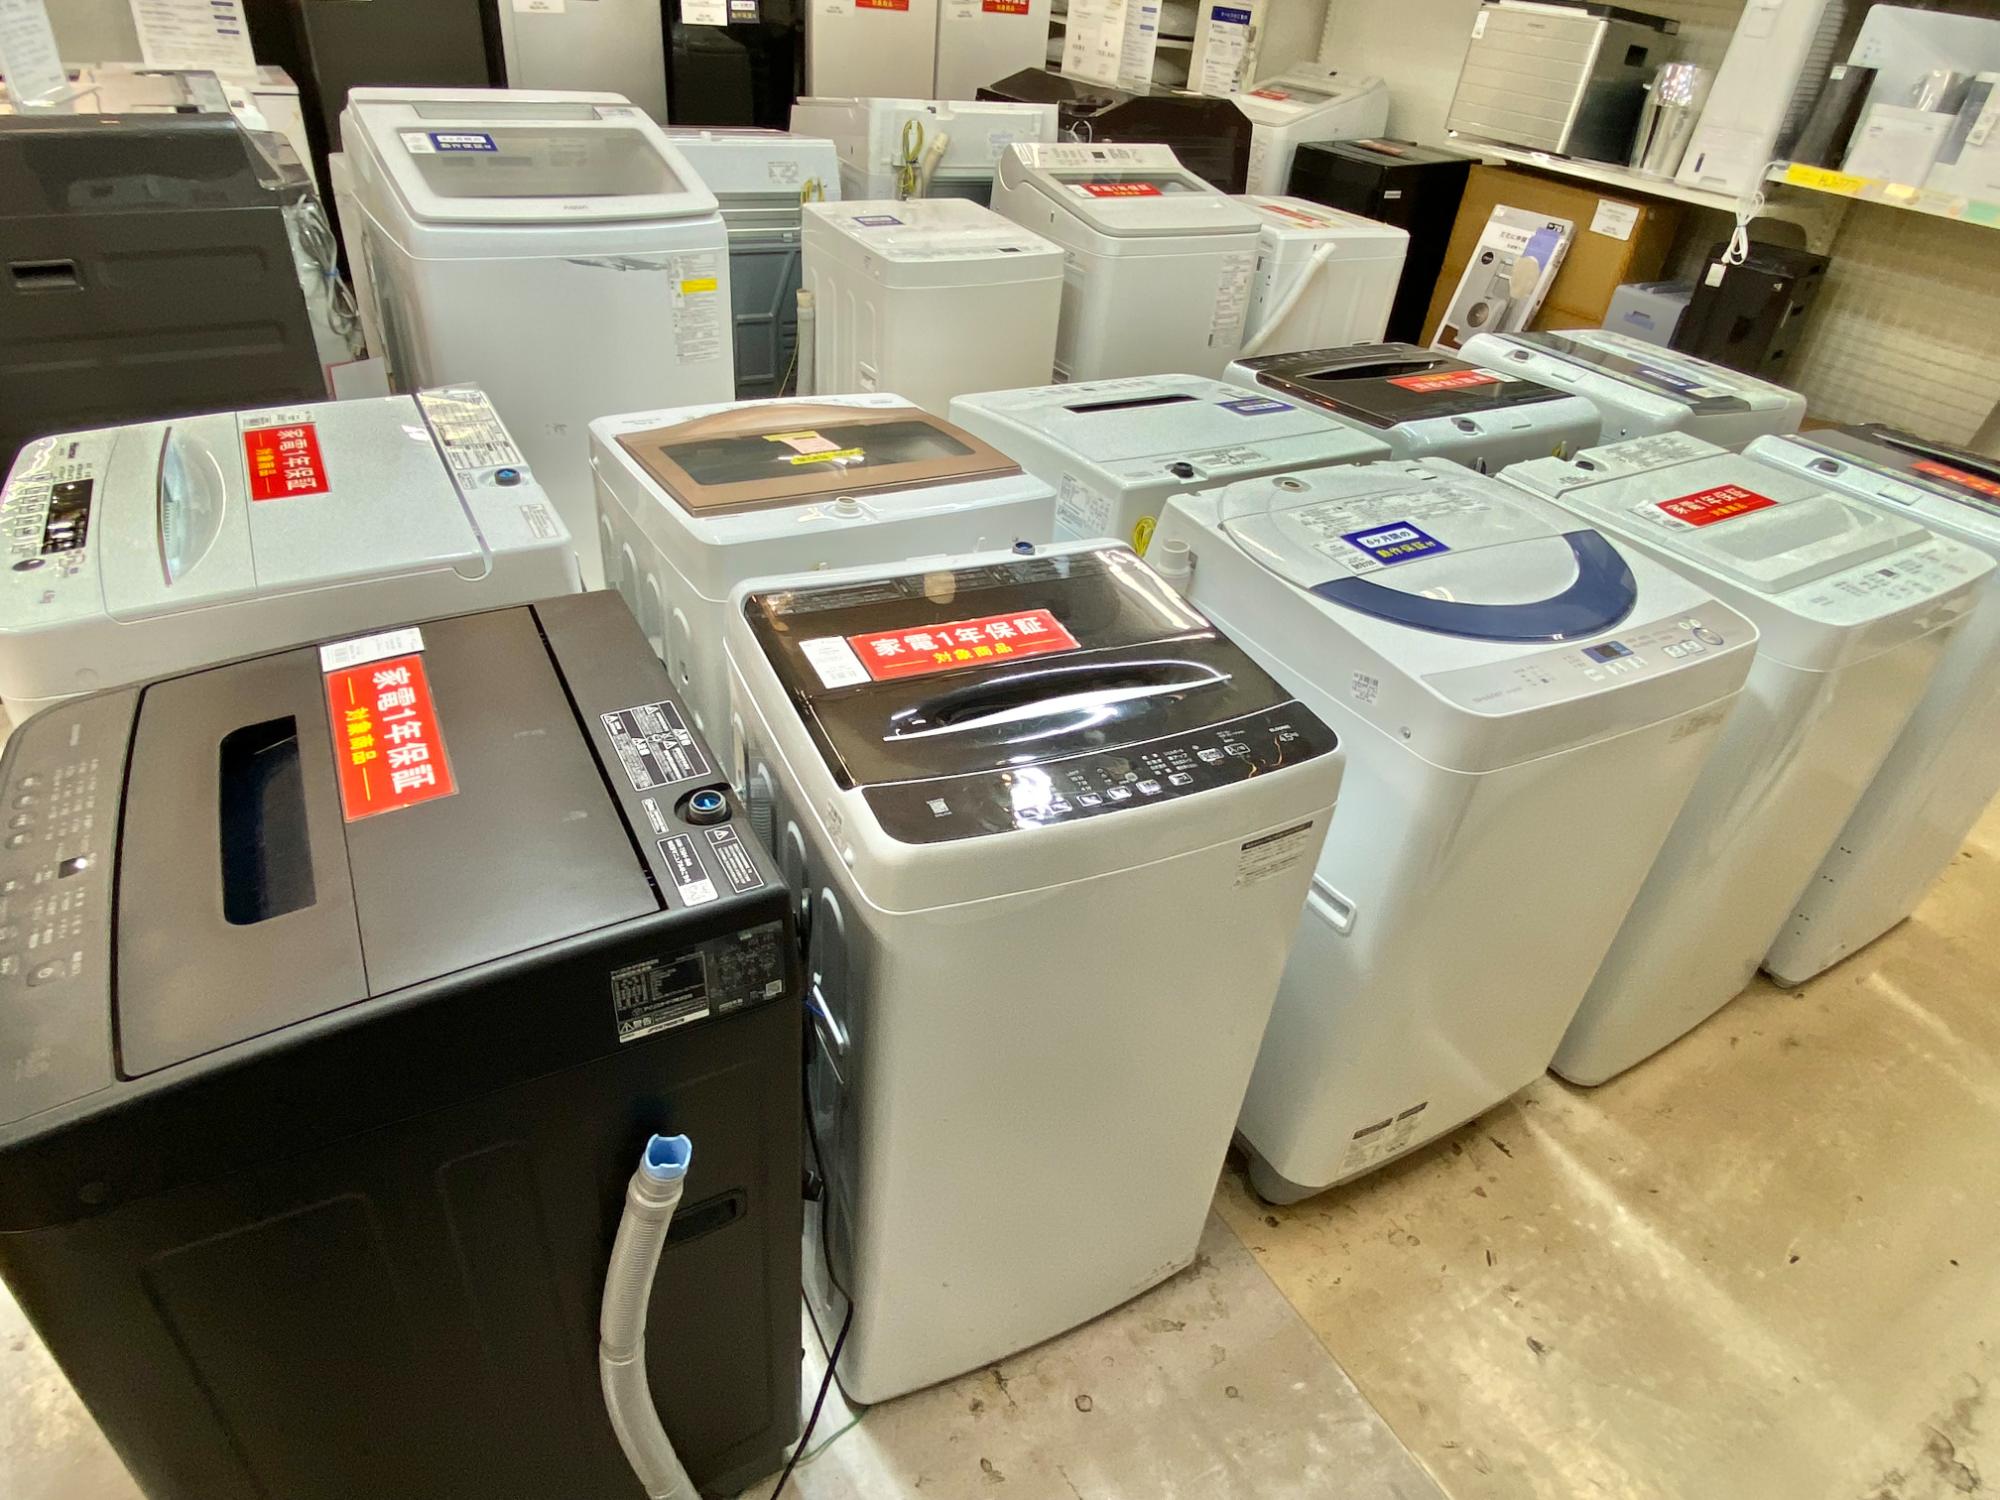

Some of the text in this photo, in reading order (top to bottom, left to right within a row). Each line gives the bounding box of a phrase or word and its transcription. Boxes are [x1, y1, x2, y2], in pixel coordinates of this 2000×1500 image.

[277, 427, 318, 490] 家電1年保証
[1665, 488, 1751, 515] 家電1年保証
[870, 616, 1048, 657] 家電1年保証
[933, 642, 1014, 664] 対象商品
[345, 707, 377, 766] 対象商品
[372, 665, 436, 793] 家電1年保証
